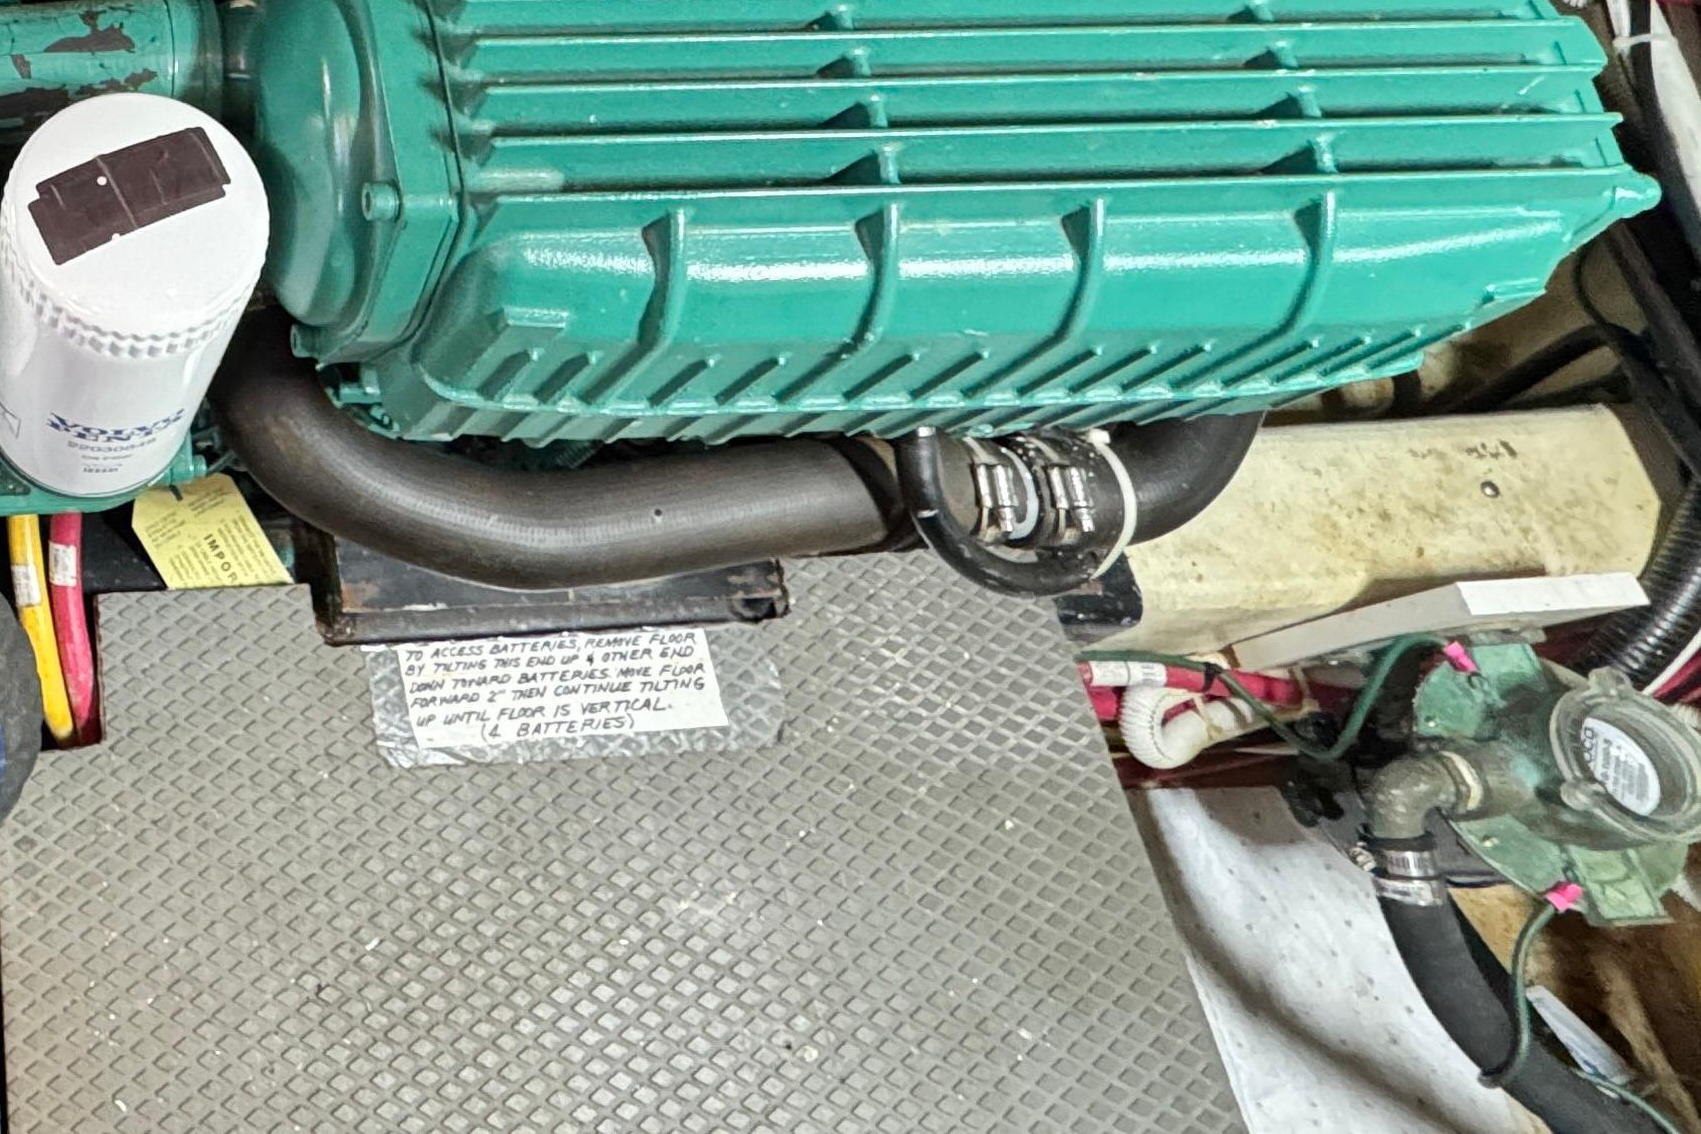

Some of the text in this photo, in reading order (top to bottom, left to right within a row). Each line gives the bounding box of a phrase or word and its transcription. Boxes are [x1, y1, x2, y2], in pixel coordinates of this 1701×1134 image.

[51, 408, 185, 436] VOLVO
[203, 533, 239, 584] IMPOR
[405, 649, 423, 662] TO
[431, 644, 484, 658] ACCESS
[585, 635, 641, 649] REMOVE
[649, 632, 696, 645] FLOOR
[405, 664, 425, 676] BY
[494, 657, 521, 669] THIS
[526, 655, 555, 668] END
[560, 654, 580, 665] UP
[601, 648, 653, 663] OTHER
[659, 645, 695, 659] END
[409, 679, 445, 694] DOWN
[451, 673, 511, 690] TOWARD
[659, 663, 706, 677] FLOOR
[410, 692, 480, 708] FORWARD
[511, 686, 547, 701] THEN
[553, 681, 633, 697] CONTINUE
[640, 677, 705, 693] TILTING
[416, 713, 436, 727] UP
[443, 709, 491, 726] UNTIL
[497, 705, 546, 721] FLOOR
[553, 704, 571, 718] IS
[517, 713, 635, 737] BATTERIES)
